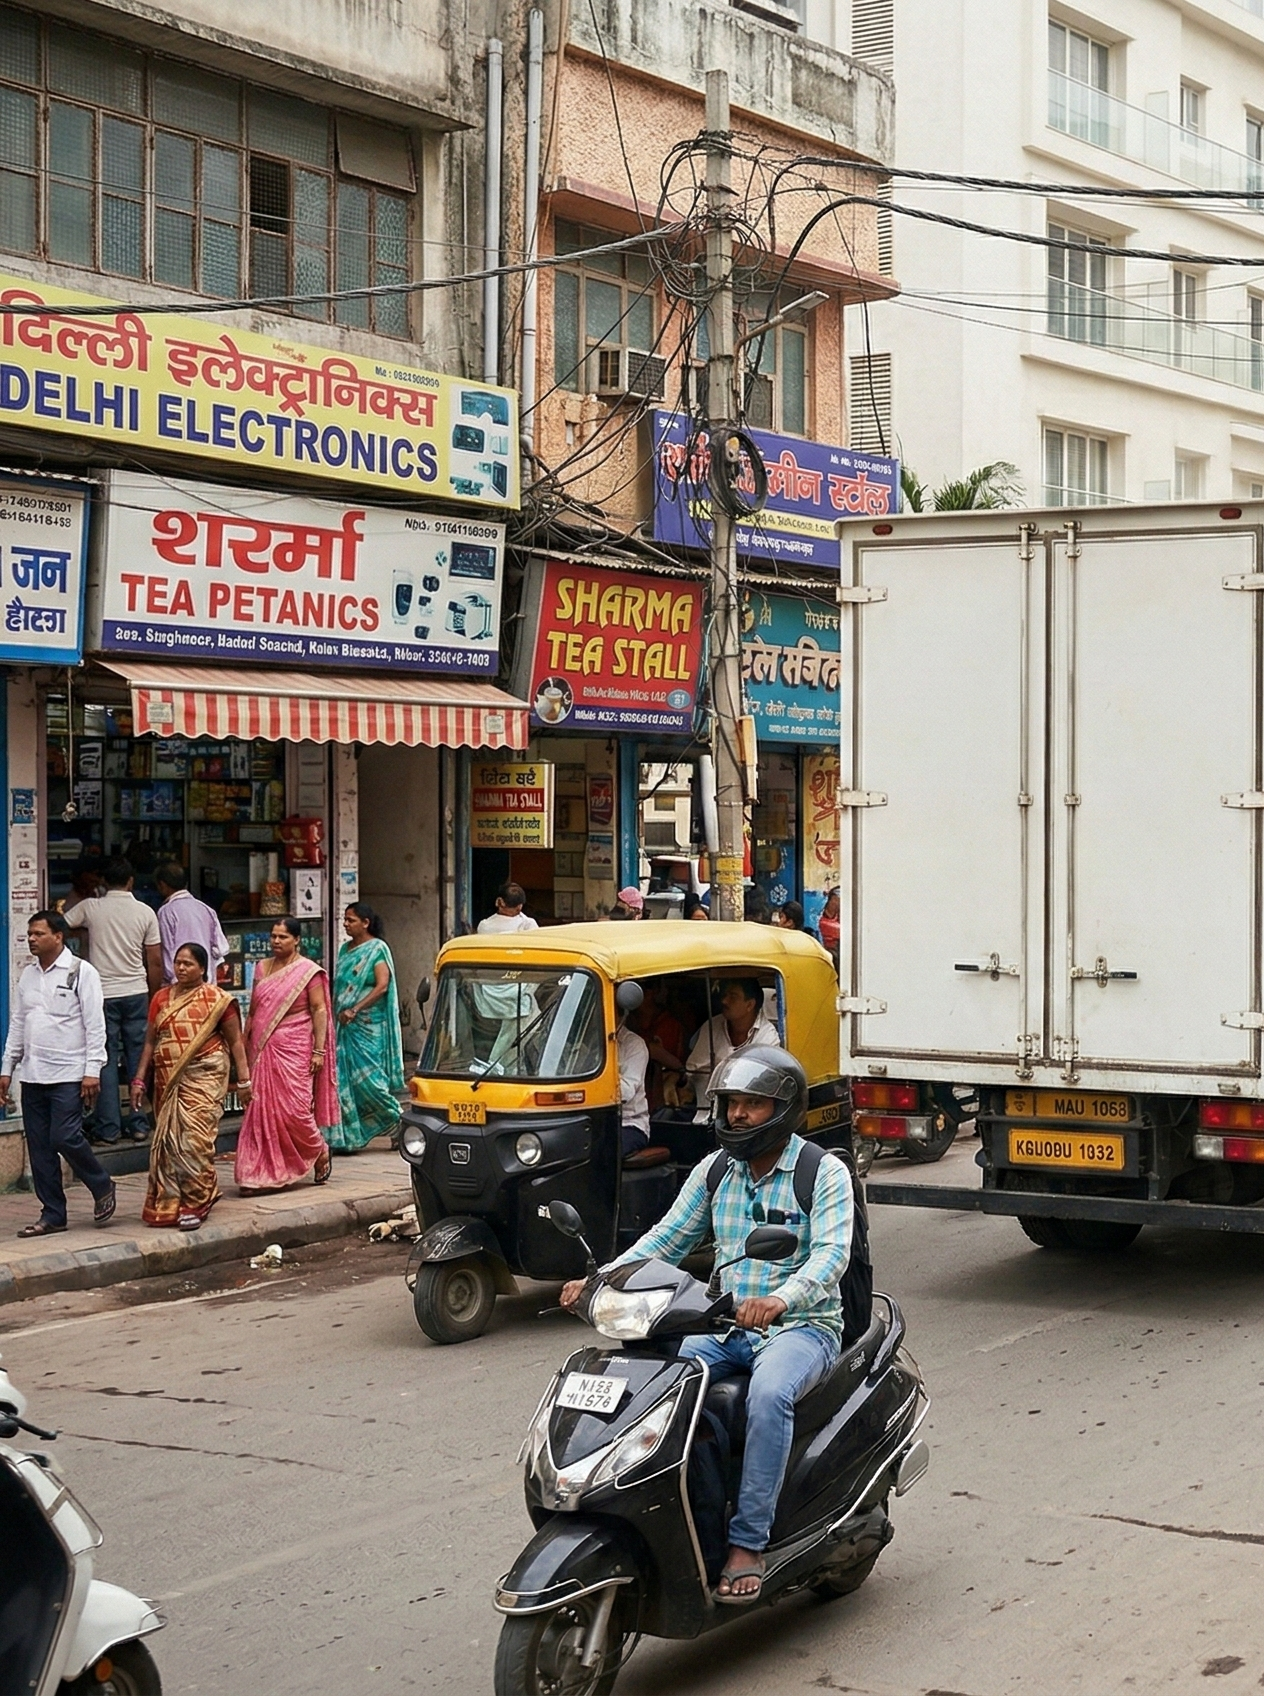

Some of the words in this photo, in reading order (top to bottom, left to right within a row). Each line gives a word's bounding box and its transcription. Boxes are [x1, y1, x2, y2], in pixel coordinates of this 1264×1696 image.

[0, 363, 140, 432] DELHI
[157, 393, 439, 483] ELECTRONICS
[11, 546, 72, 594] जन
[120, 573, 196, 617] TEA
[208, 581, 380, 632] PETANICS
[555, 577, 694, 637] SHARMA
[546, 630, 604, 677] TEA
[612, 638, 691, 682] STALL
[1054, 1098, 1085, 1115] MAU
